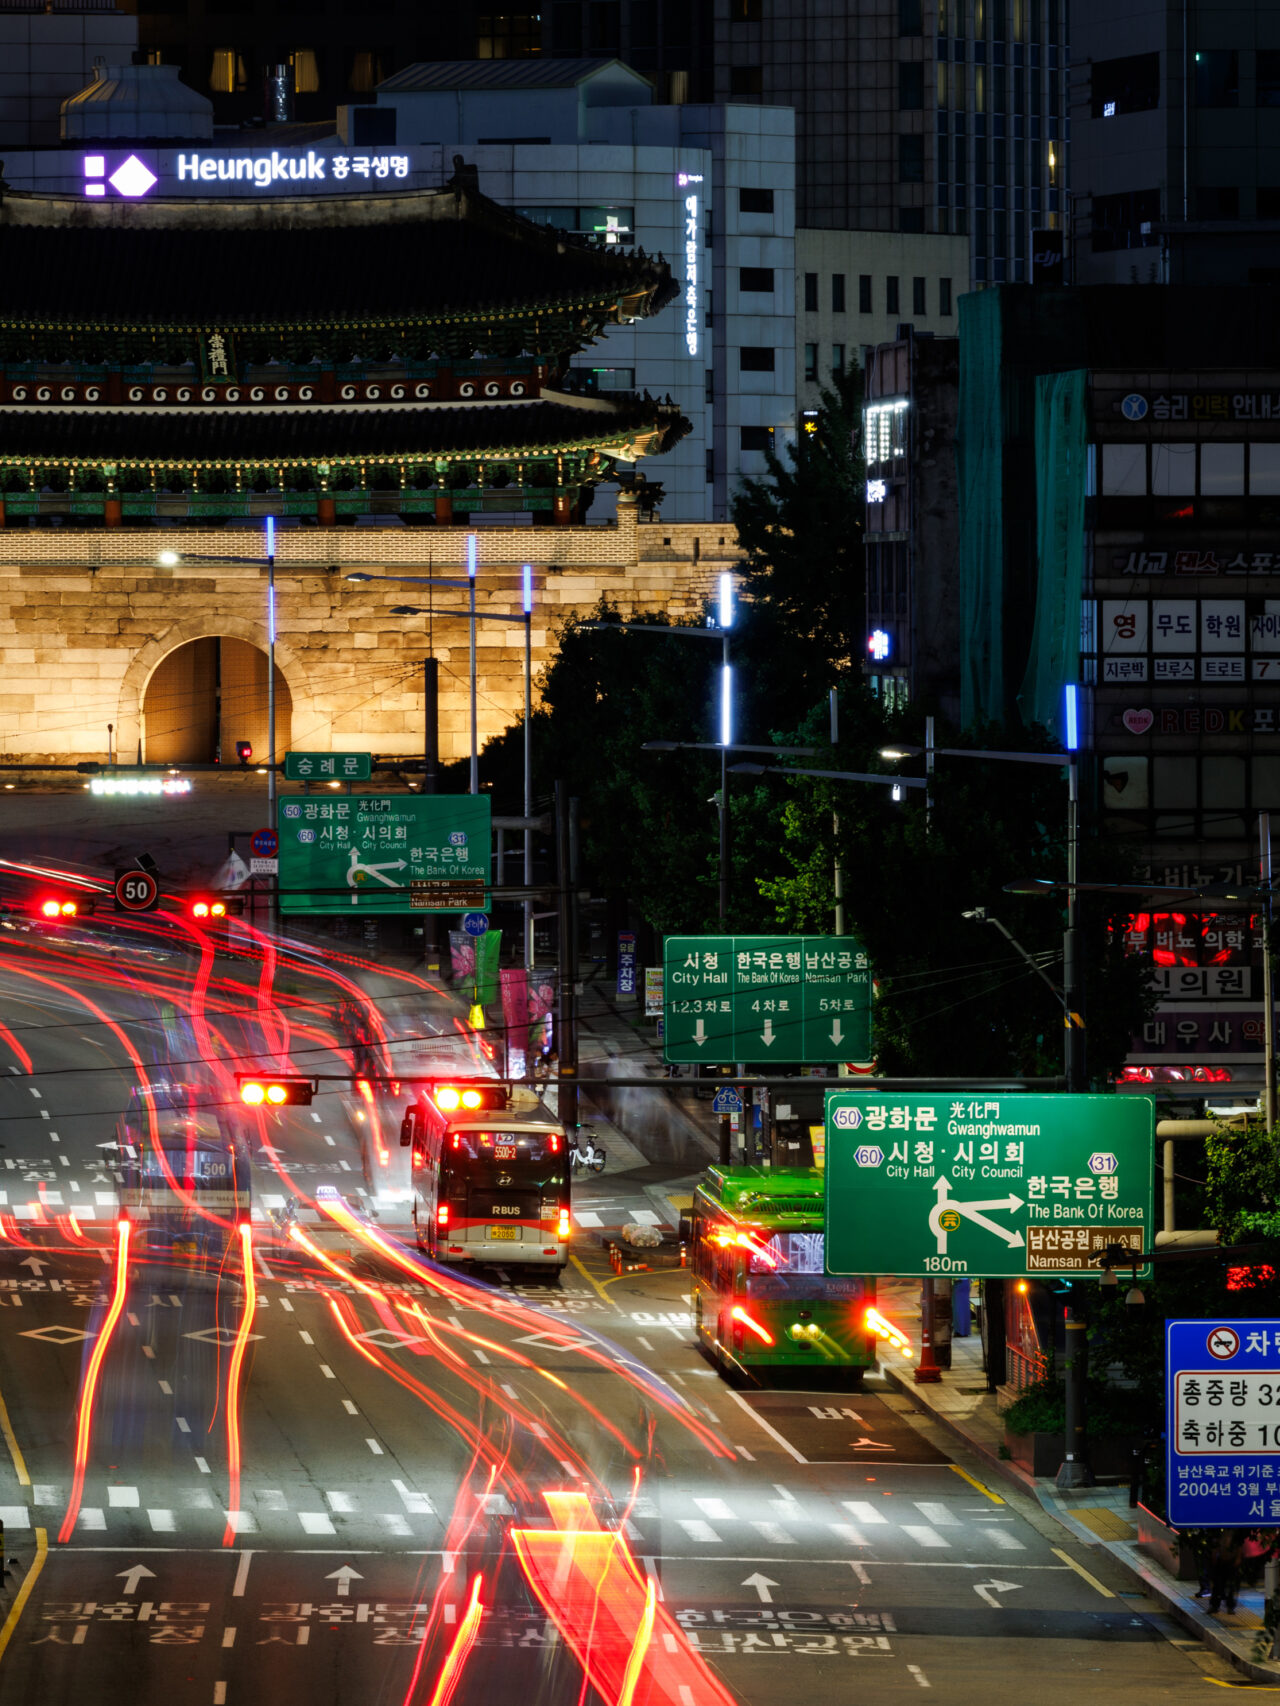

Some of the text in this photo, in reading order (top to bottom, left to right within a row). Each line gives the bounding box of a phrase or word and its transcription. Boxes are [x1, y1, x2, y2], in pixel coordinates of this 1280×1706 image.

[178, 151, 410, 187] Heungkuk 흥국생명
[1152, 394, 1189, 420] 승리
[1192, 394, 1229, 420] 인력
[1122, 552, 1168, 575] 사교
[1175, 550, 1221, 577] 댄스
[1113, 614, 1136, 639] 영
[1252, 615, 1280, 639] 자이
[1106, 662, 1144, 678] 지루박
[1156, 662, 1193, 676] 브루스
[1205, 662, 1242, 676] 트로트
[297, 757, 359, 775] 숭례문
[286, 807, 300, 817] 50
[304, 803, 351, 819] 광화문
[357, 812, 416, 824] Gwanghwamun
[301, 831, 314, 841] 60
[320, 826, 408, 841] 시청 시의회
[451, 834, 464, 844] 31
[320, 841, 407, 850] City Hall City Council
[410, 847, 469, 863] 한국은행
[410, 866, 485, 875] The Bank Of Korea
[125, 881, 148, 899] 50
[449, 897, 468, 907] Park
[683, 952, 718, 970] 시청
[736, 952, 801, 970] 한국은행
[805, 952, 868, 969] 남산공원
[620, 954, 634, 992] 주차장
[672, 972, 728, 986] City Hall
[737, 973, 800, 983] The Bank Of Korea
[805, 973, 868, 983] Namsan Park
[838, 1111, 858, 1126] 50
[864, 1106, 938, 1131] 광화문
[949, 1102, 1001, 1119] 光化門
[947, 1121, 1041, 1139] Gwanghwamun
[860, 1149, 878, 1164] 60
[888, 1140, 1025, 1165] 시청 시의회
[203, 1163, 227, 1176] 500
[1093, 1156, 1113, 1171] 31
[886, 1165, 1024, 1180] City Hall City Council
[1027, 1176, 1119, 1199] 한국은행
[1027, 1203, 1144, 1219] The Bank Of Korea
[1029, 1229, 1090, 1250] 남산공원
[923, 1257, 968, 1272] 180m
[1029, 1254, 1082, 1269] Namsan
[1245, 1330, 1280, 1357] 차
[1183, 1379, 1248, 1406] 총중량
[1182, 1419, 1247, 1447] 축하중
[1177, 1464, 1274, 1478] 남산육교 위 기준
[1179, 1482, 1231, 1496] 2004년
[1237, 1482, 1259, 1496] 3월
